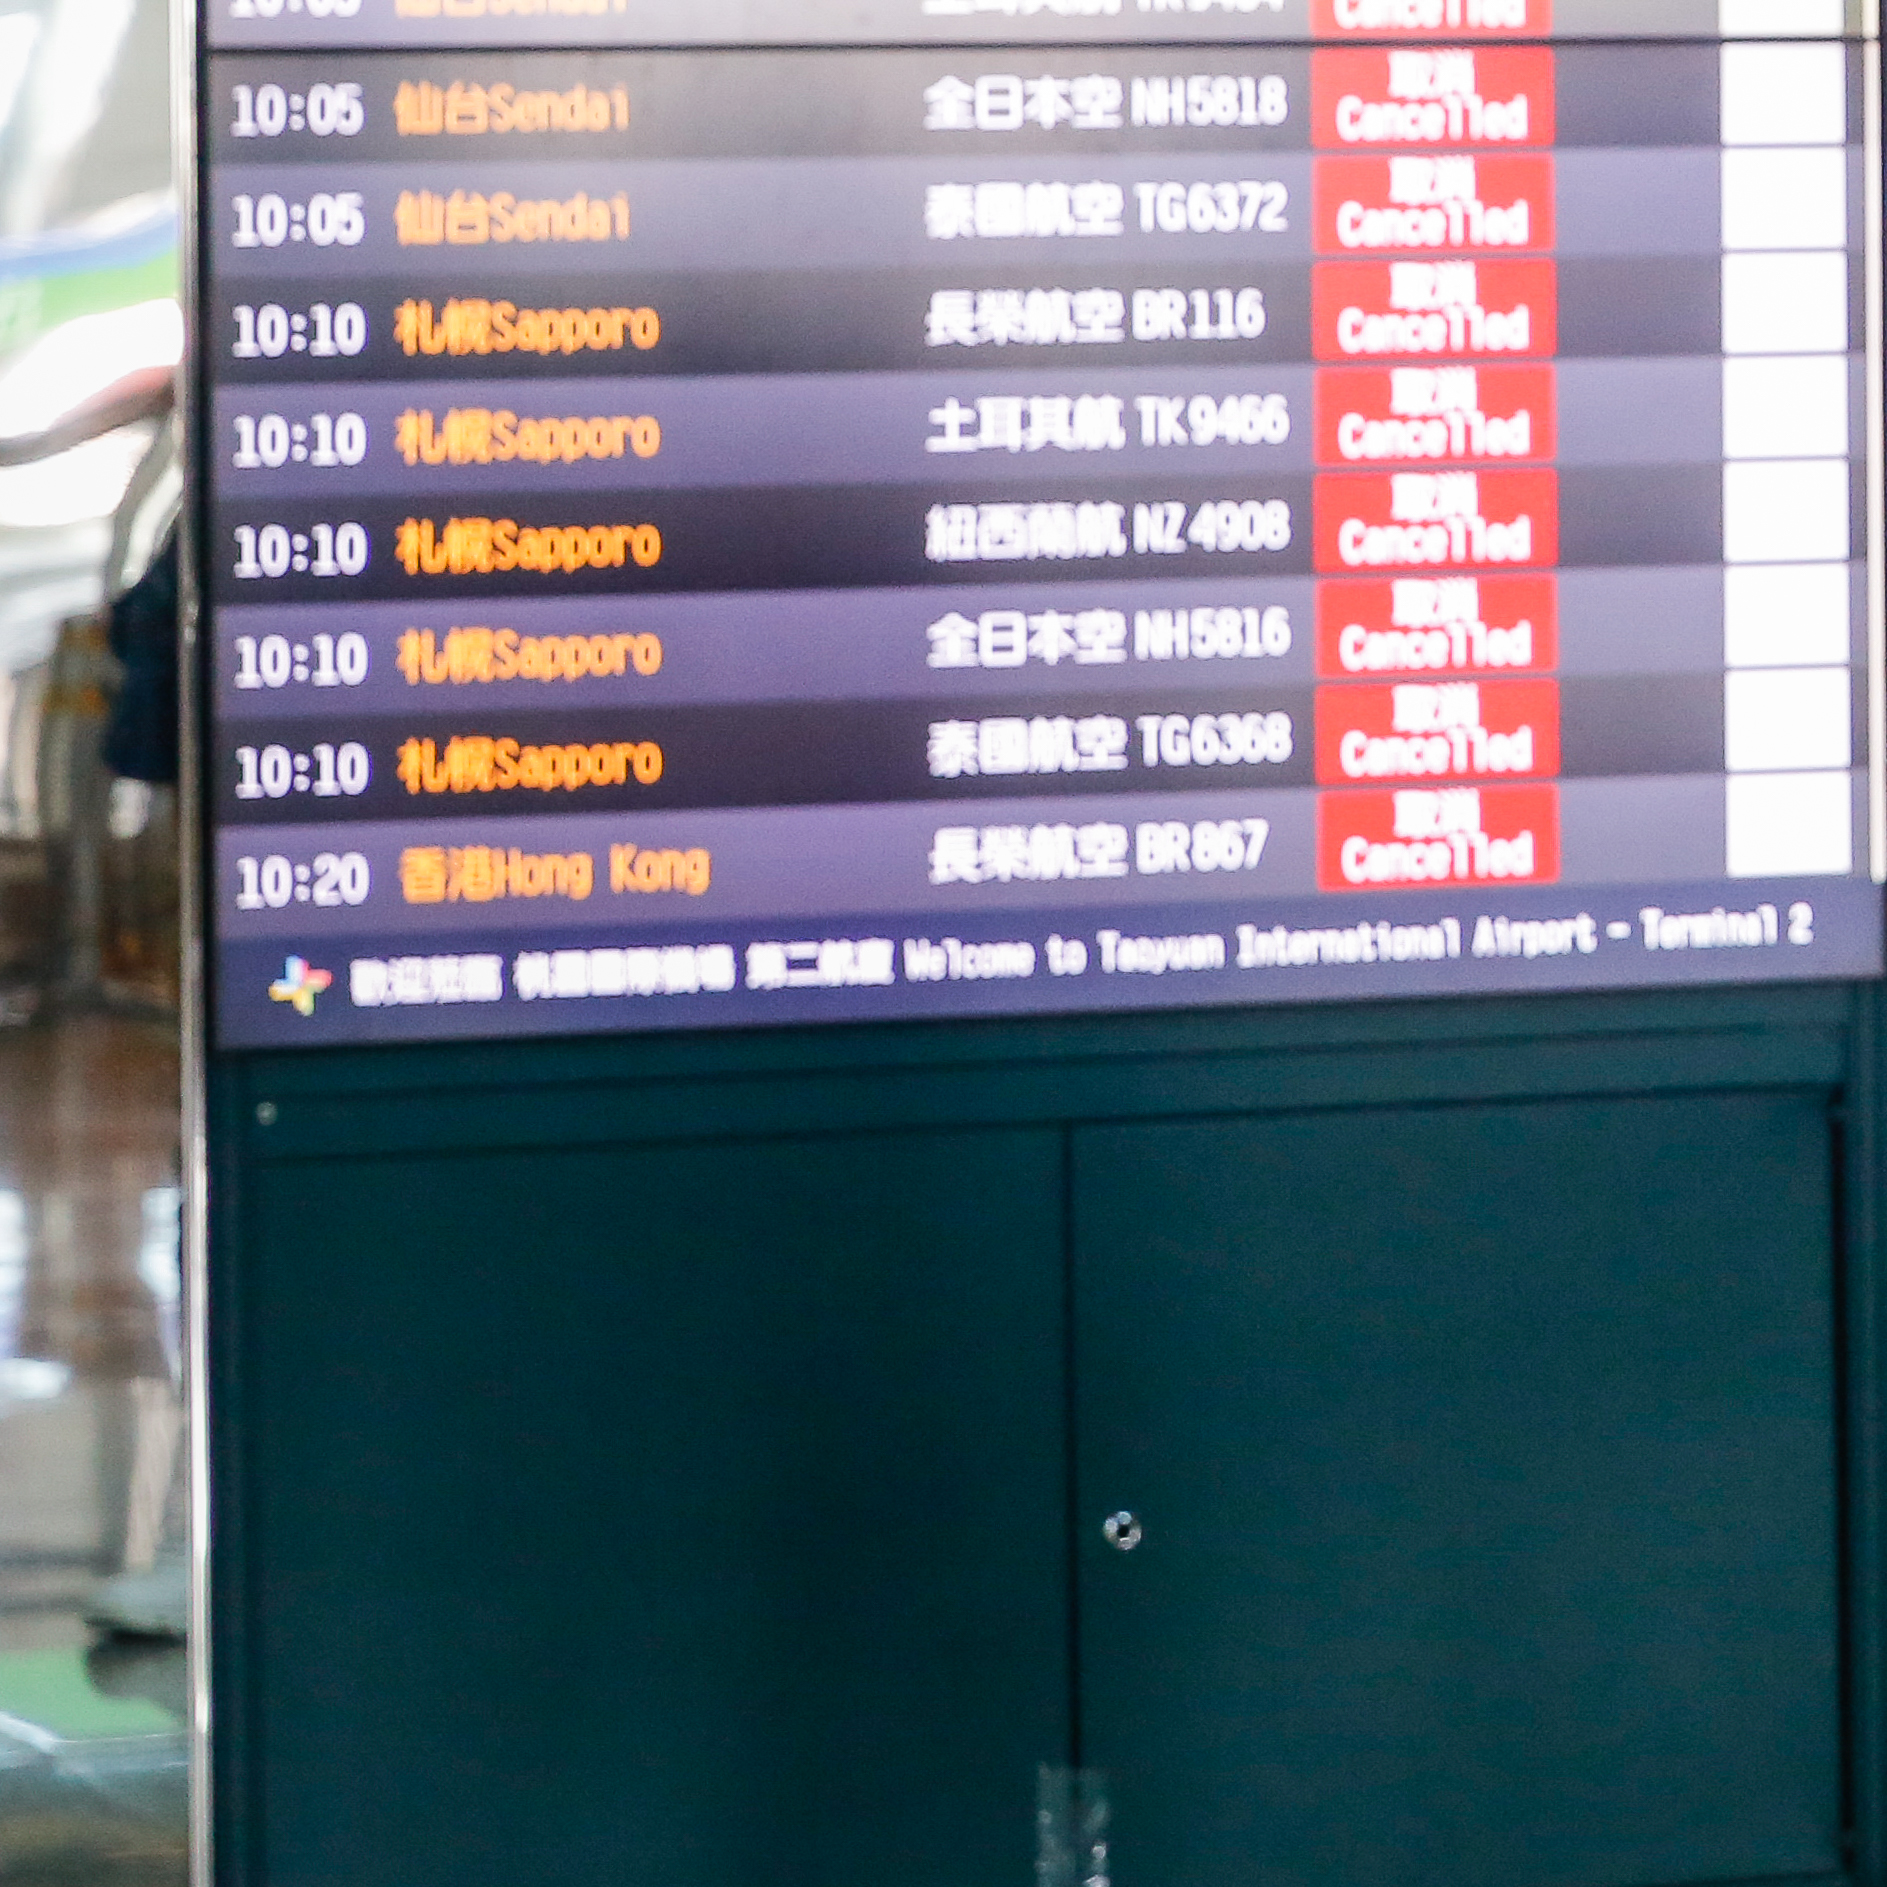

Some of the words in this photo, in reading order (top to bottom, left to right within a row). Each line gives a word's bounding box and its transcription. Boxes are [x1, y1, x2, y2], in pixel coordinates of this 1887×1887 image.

[234, 84, 364, 135] 10:05
[1131, 76, 1286, 125] NH5818
[234, 193, 364, 245] 10:05
[1134, 181, 1287, 231] TG6372
[234, 304, 365, 357] 10:10
[1133, 288, 1264, 339] BR116
[1338, 306, 1529, 353] Cancelled
[235, 413, 366, 466] 10:10
[1135, 395, 1289, 445] TK9466
[235, 523, 367, 578] 10:10
[1134, 500, 1290, 552] NZ4908
[236, 633, 368, 688] 10:10
[1135, 606, 1291, 658] NH5816
[237, 742, 368, 798] 10:10
[1138, 712, 1291, 765] TG6368
[1341, 727, 1533, 776] Cancelled
[238, 853, 369, 908] 10:20
[610, 845, 711, 895] Kong
[1137, 819, 1268, 873] BR867
[1342, 831, 1533, 882] Cancelled
[905, 939, 1034, 979] Welcome
[1047, 937, 1086, 974] to
[1237, 918, 1460, 967] International
[1472, 913, 1597, 957] Airport
[1640, 905, 1777, 950] Terminal
[1788, 903, 1813, 944] 2
